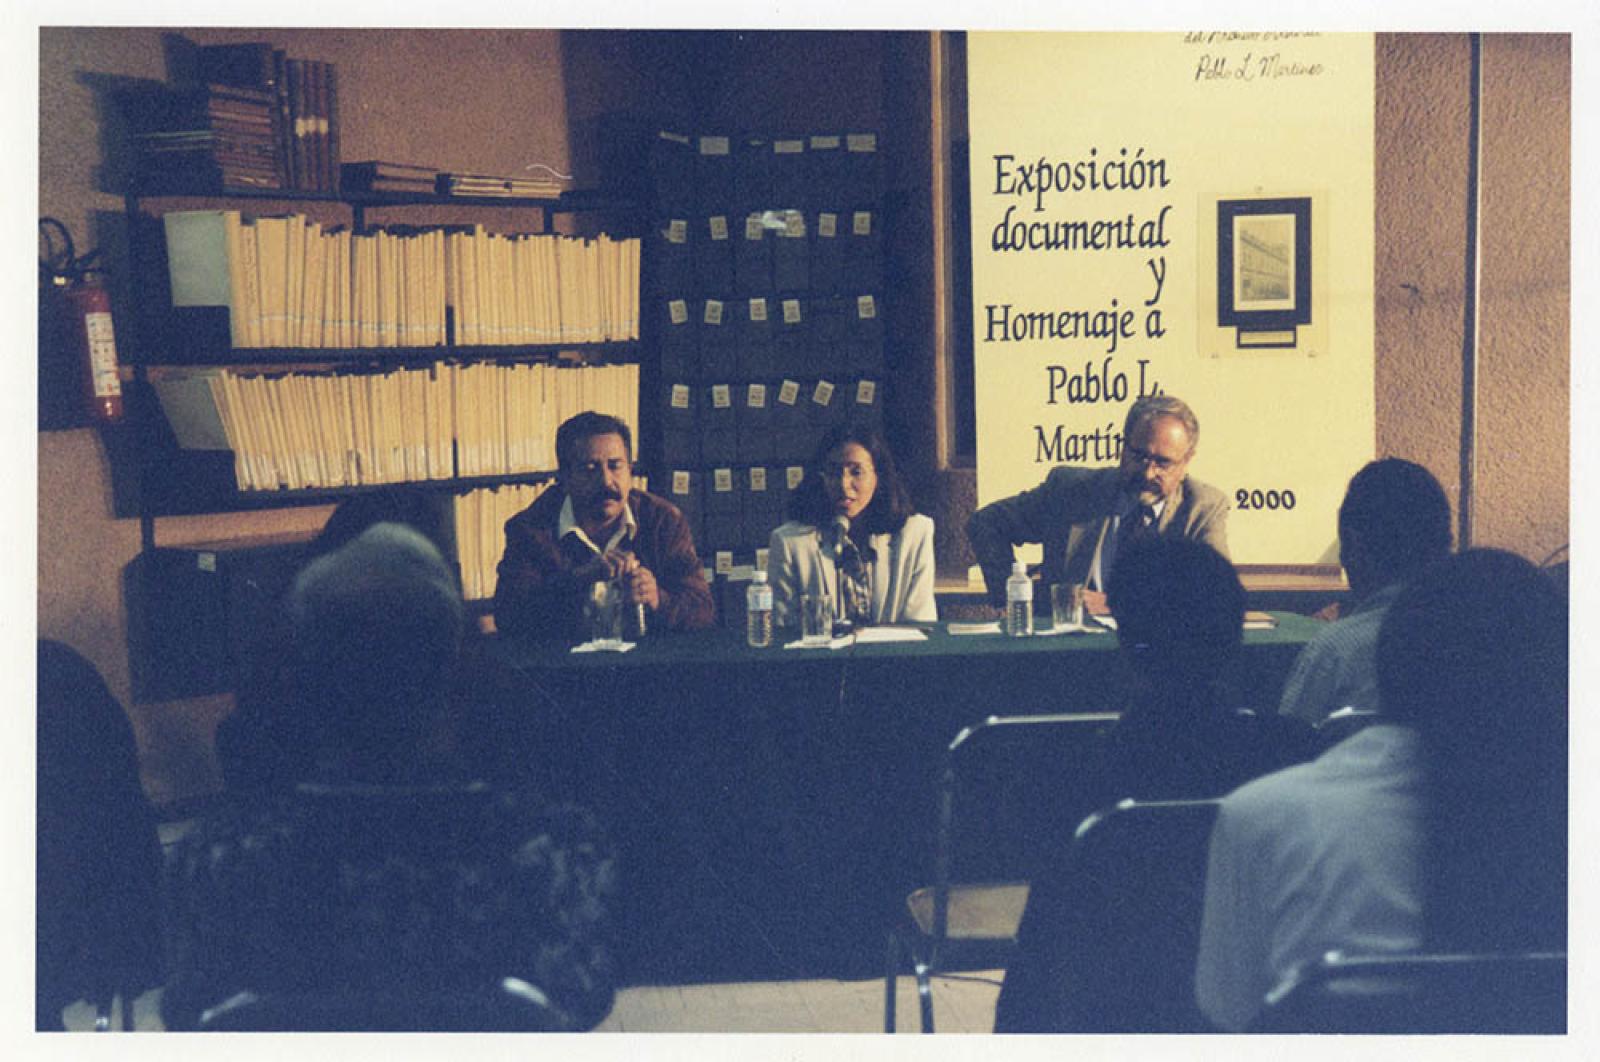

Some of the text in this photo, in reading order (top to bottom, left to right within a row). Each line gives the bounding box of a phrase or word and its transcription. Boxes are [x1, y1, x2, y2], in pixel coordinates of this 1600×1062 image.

[993, 148, 1170, 211] Exposición
[992, 205, 1172, 251] documental
[1144, 256, 1166, 306] y
[984, 299, 1166, 353] Homenaje a
[1046, 357, 1128, 404] Pablo
[1034, 422, 1125, 463] Martín
[1235, 488, 1297, 511] 2000
